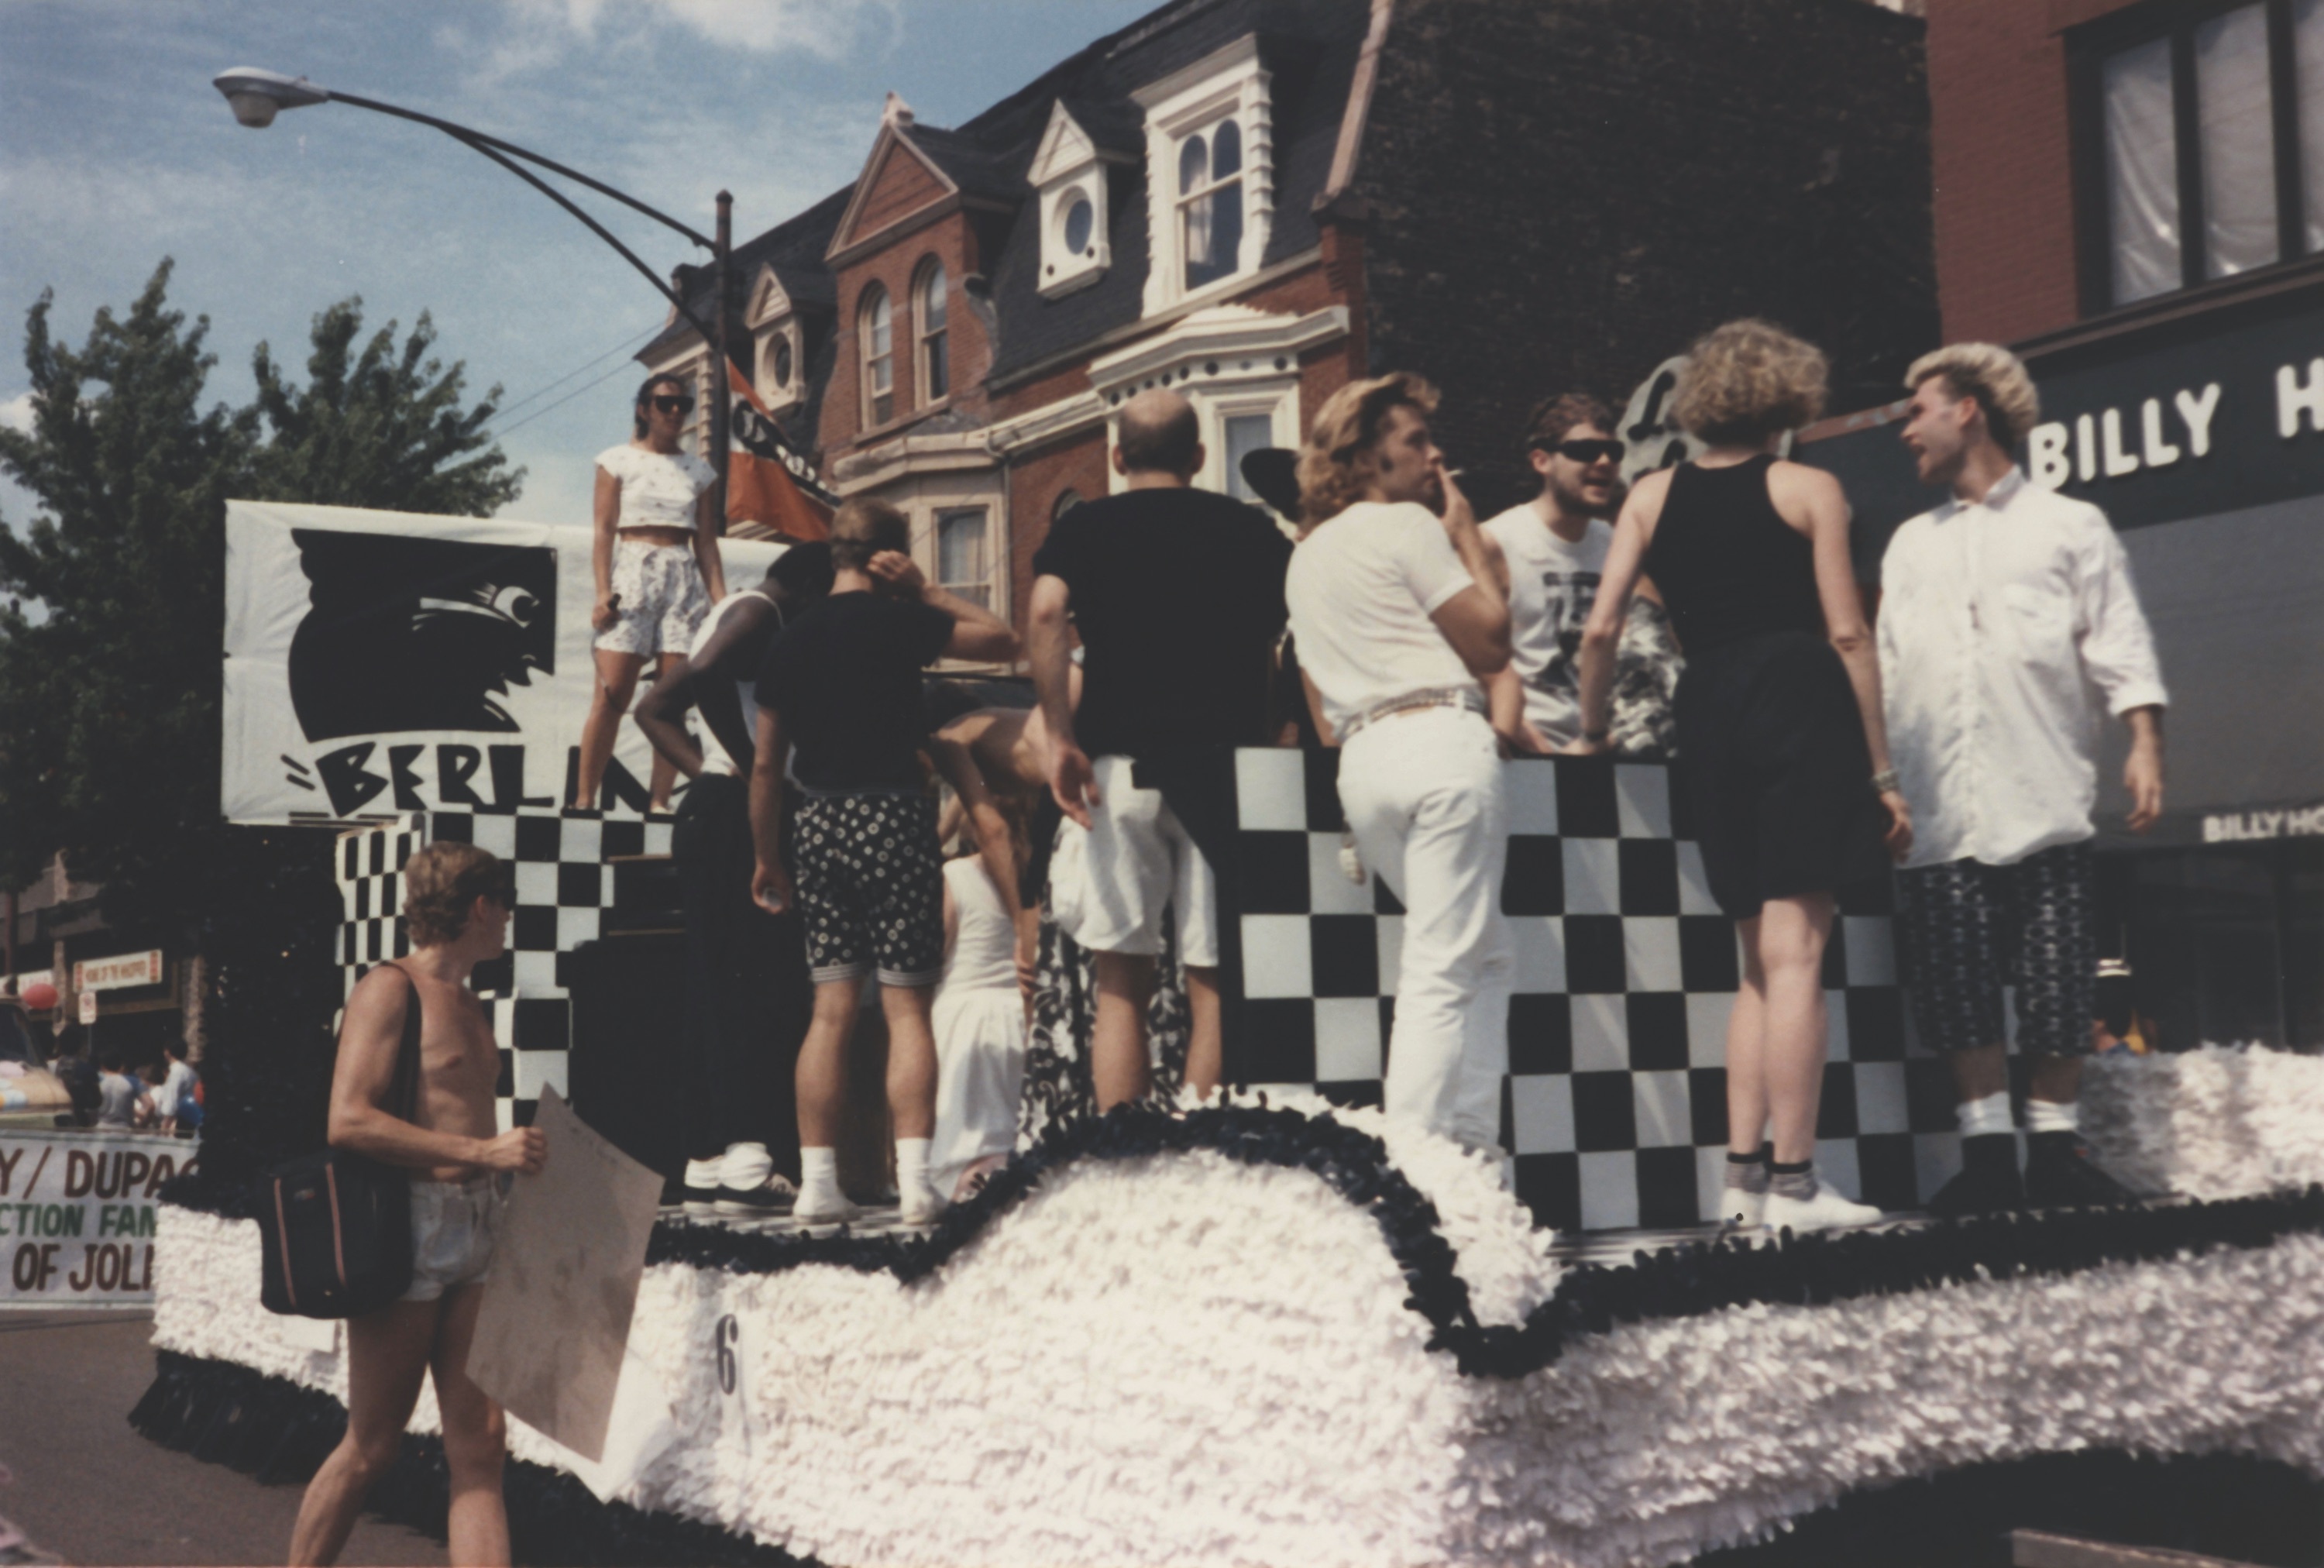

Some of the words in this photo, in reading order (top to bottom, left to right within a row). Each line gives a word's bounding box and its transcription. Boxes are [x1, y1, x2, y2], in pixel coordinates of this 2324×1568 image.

[2028, 383, 2221, 493] BILLY
[315, 741, 657, 817] BERLIN
[2203, 810, 2281, 843] BILLY
[12, 1243, 60, 1291] OF
[717, 1313, 738, 1395] 6
